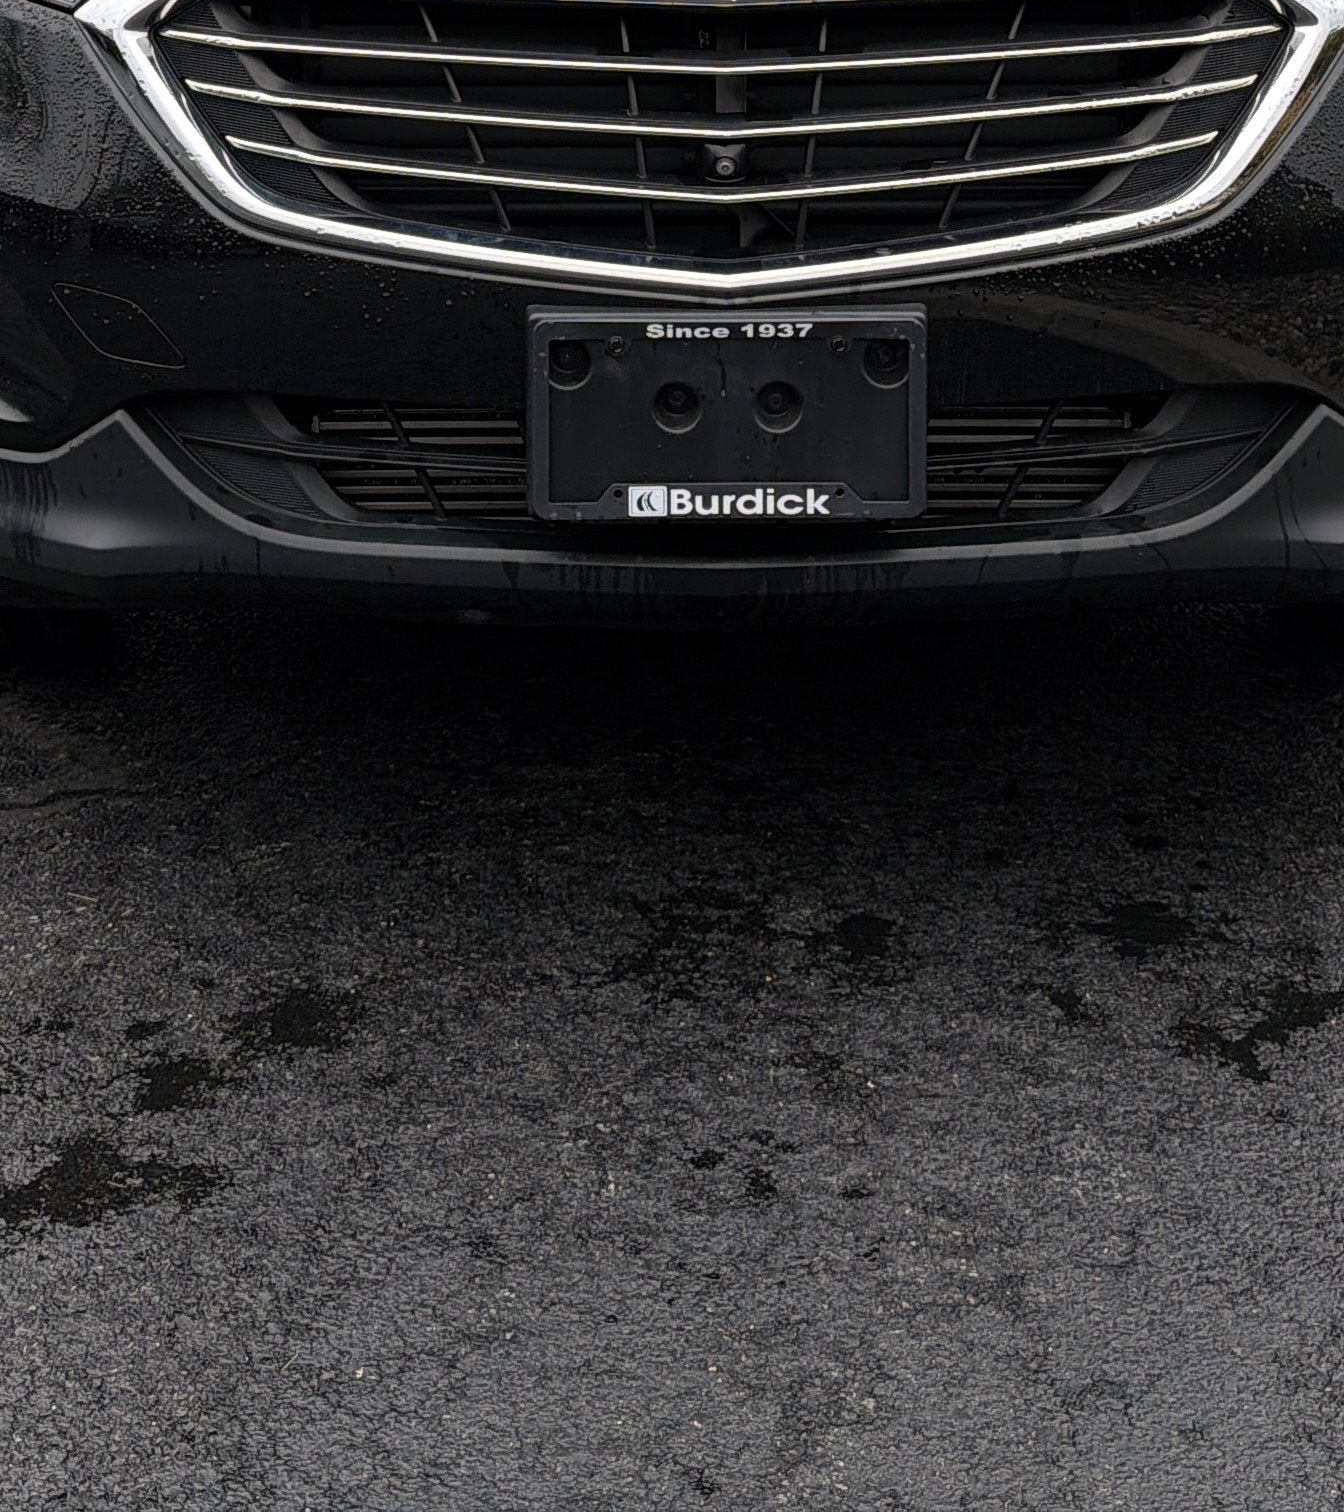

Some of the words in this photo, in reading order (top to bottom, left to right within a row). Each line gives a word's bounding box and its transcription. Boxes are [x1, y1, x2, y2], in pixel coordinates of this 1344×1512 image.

[646, 324, 730, 338] Since
[741, 323, 814, 338] 1937
[670, 488, 831, 515] Burdick
